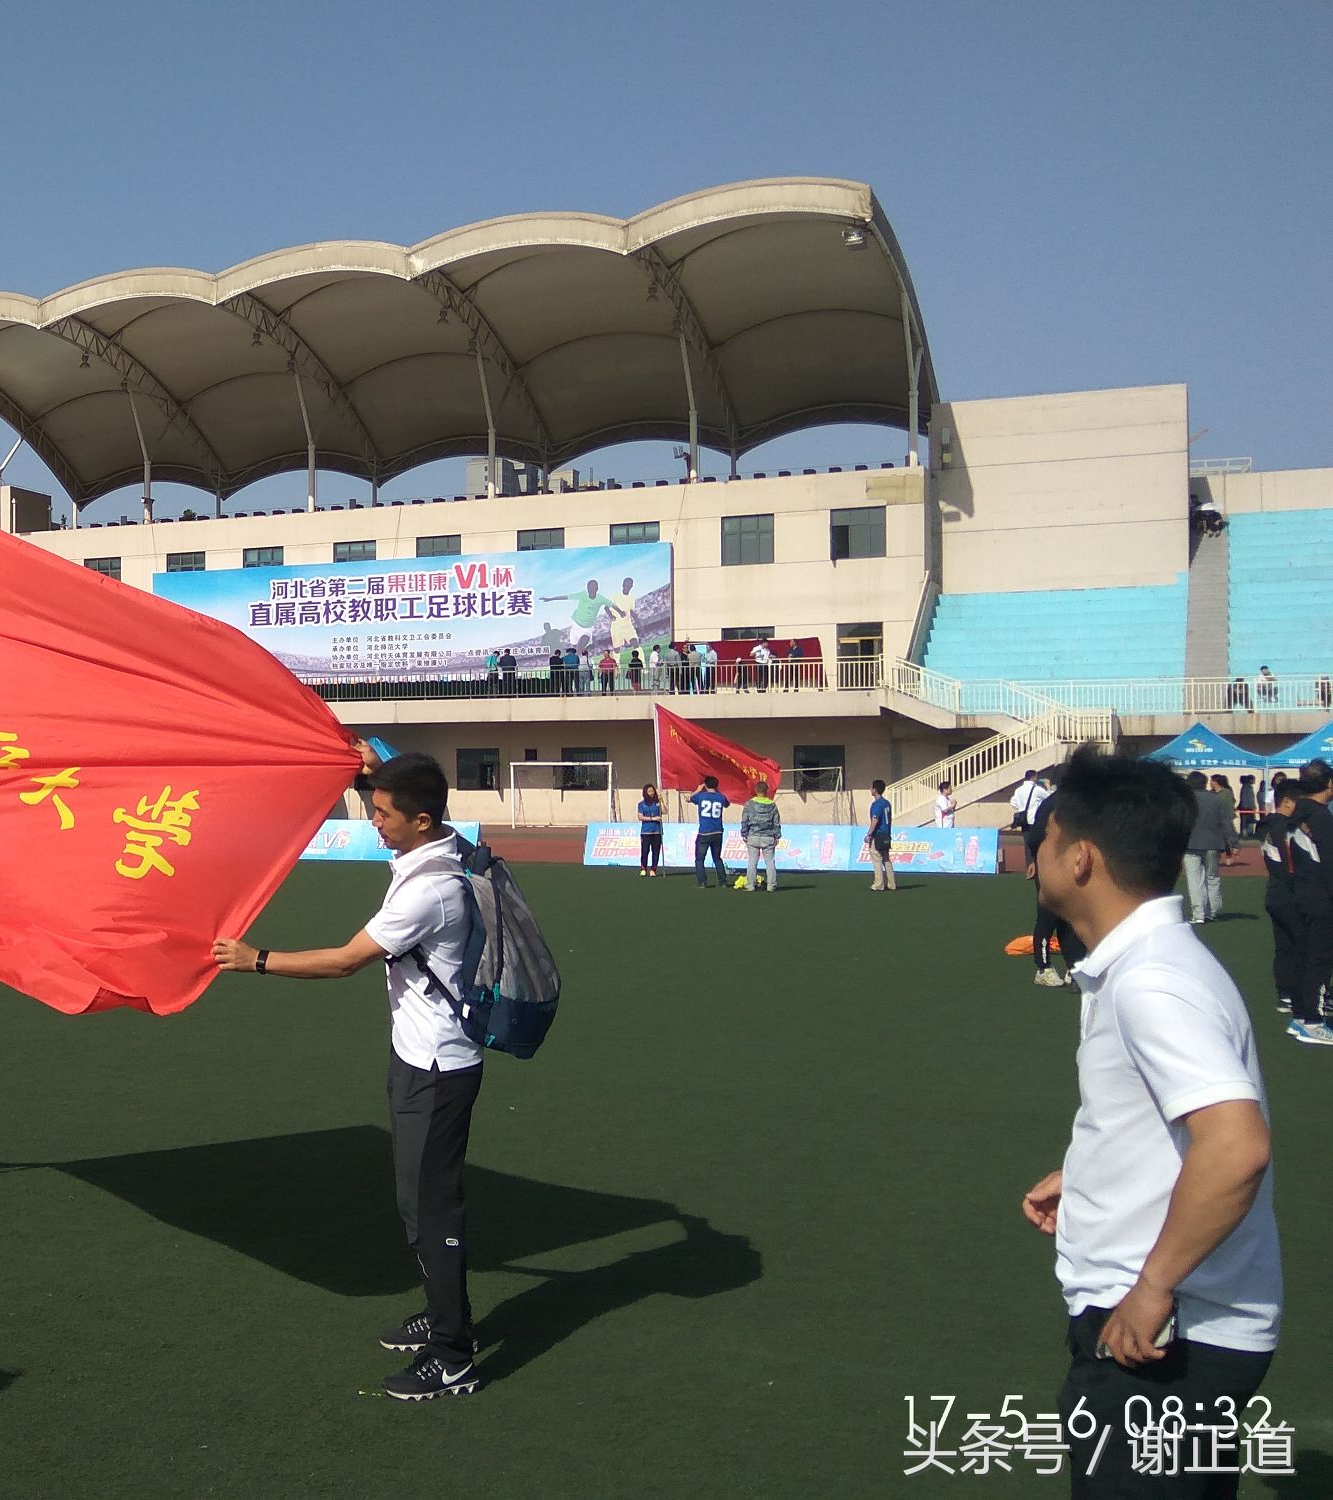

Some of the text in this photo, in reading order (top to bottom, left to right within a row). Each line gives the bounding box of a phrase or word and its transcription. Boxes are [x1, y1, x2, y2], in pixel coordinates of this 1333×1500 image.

[249, 589, 533, 626] 直属高校教职工足球比赛
[332, 637, 359, 645] 主办单位
[332, 643, 409, 654] 承办单位 河北师范大学
[700, 799, 723, 819] 26
